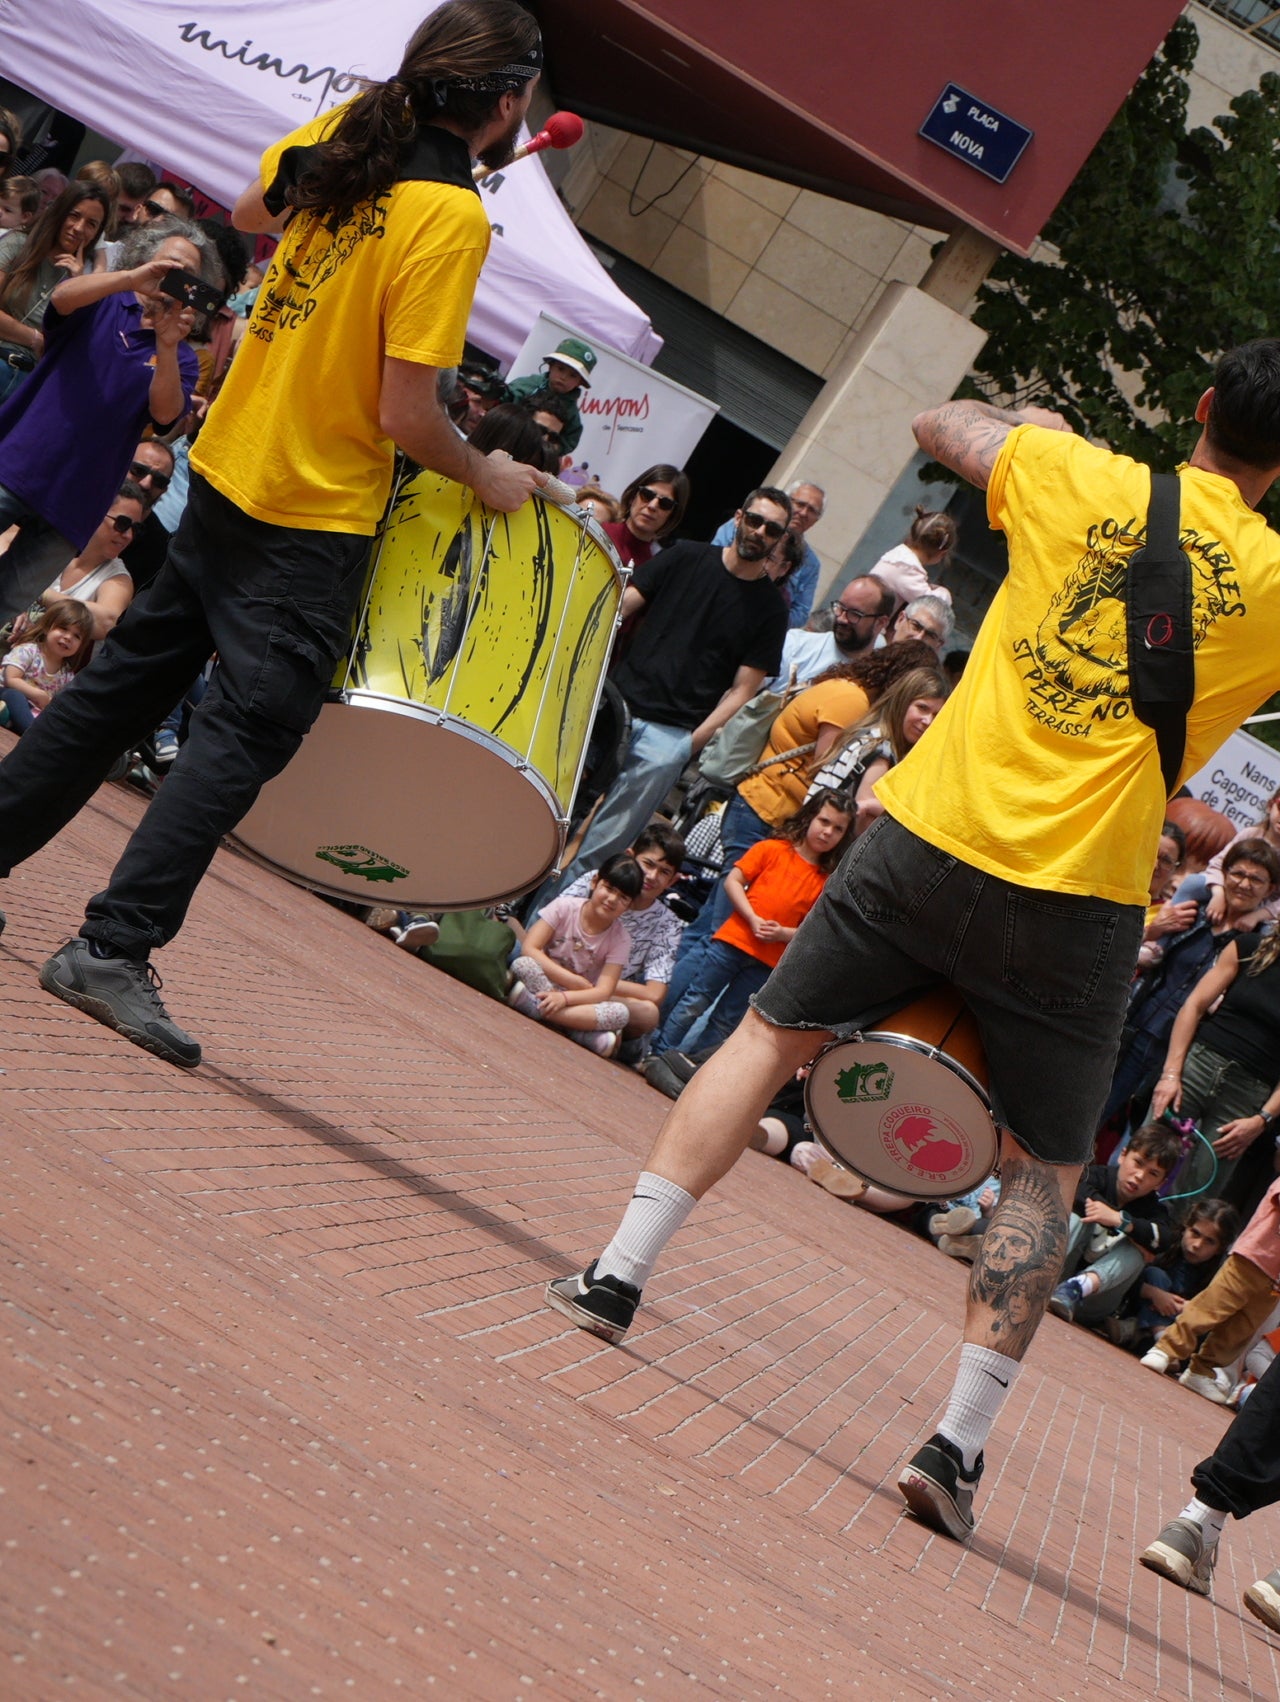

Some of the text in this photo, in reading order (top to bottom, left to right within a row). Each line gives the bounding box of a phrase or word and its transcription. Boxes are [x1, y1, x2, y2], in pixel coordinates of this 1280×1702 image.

[178, 22, 367, 118] minyo
[967, 106, 1000, 132] PLACA
[949, 130, 985, 160] NOVA
[579, 391, 649, 455] inyons
[1087, 518, 1147, 549] COLL
[1023, 667, 1087, 716] PERE
[1091, 699, 1130, 721] NO
[1023, 697, 1092, 738] TERRASSA
[1211, 769, 1267, 815] Capgros
[1240, 761, 1277, 793] Nans
[1201, 789, 1256, 829] de Terra
[883, 1105, 931, 1129] COQUEIRO
[883, 1131, 902, 1162] TREPA
